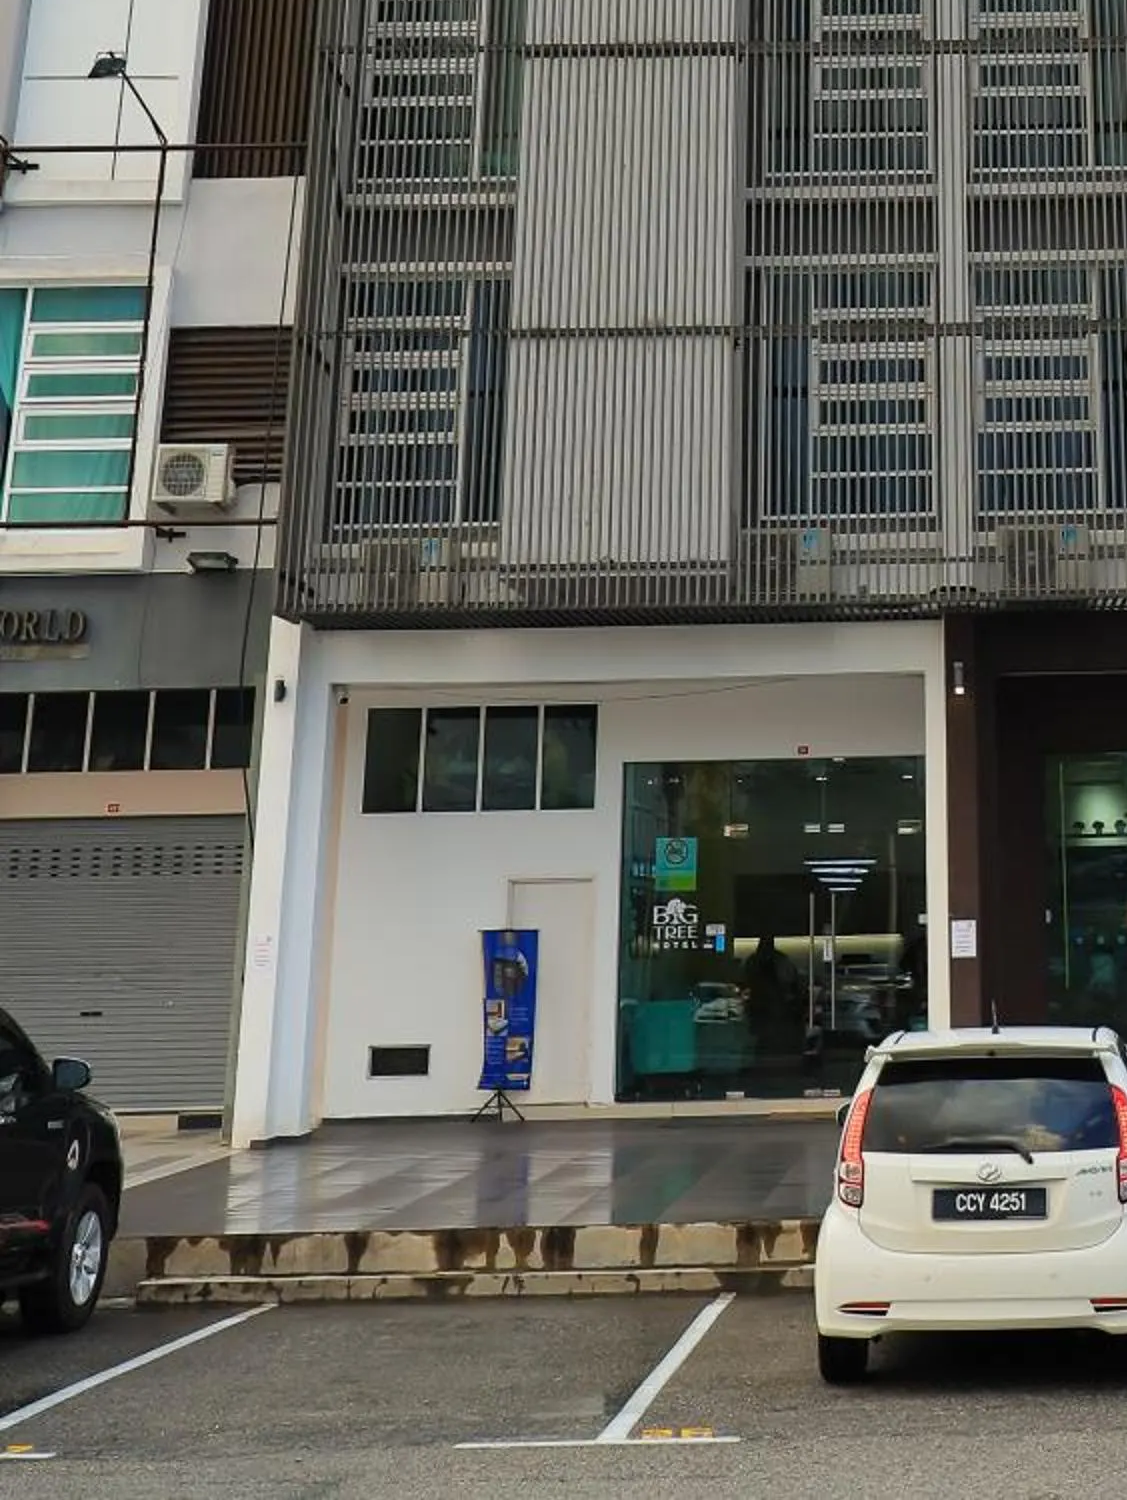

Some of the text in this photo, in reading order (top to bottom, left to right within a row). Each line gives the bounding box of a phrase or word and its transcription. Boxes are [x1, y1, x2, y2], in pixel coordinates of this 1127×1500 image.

[0, 610, 86, 641] ORLD
[652, 925, 699, 940] TREE
[955, 1191, 1026, 1212] CCY 4251
